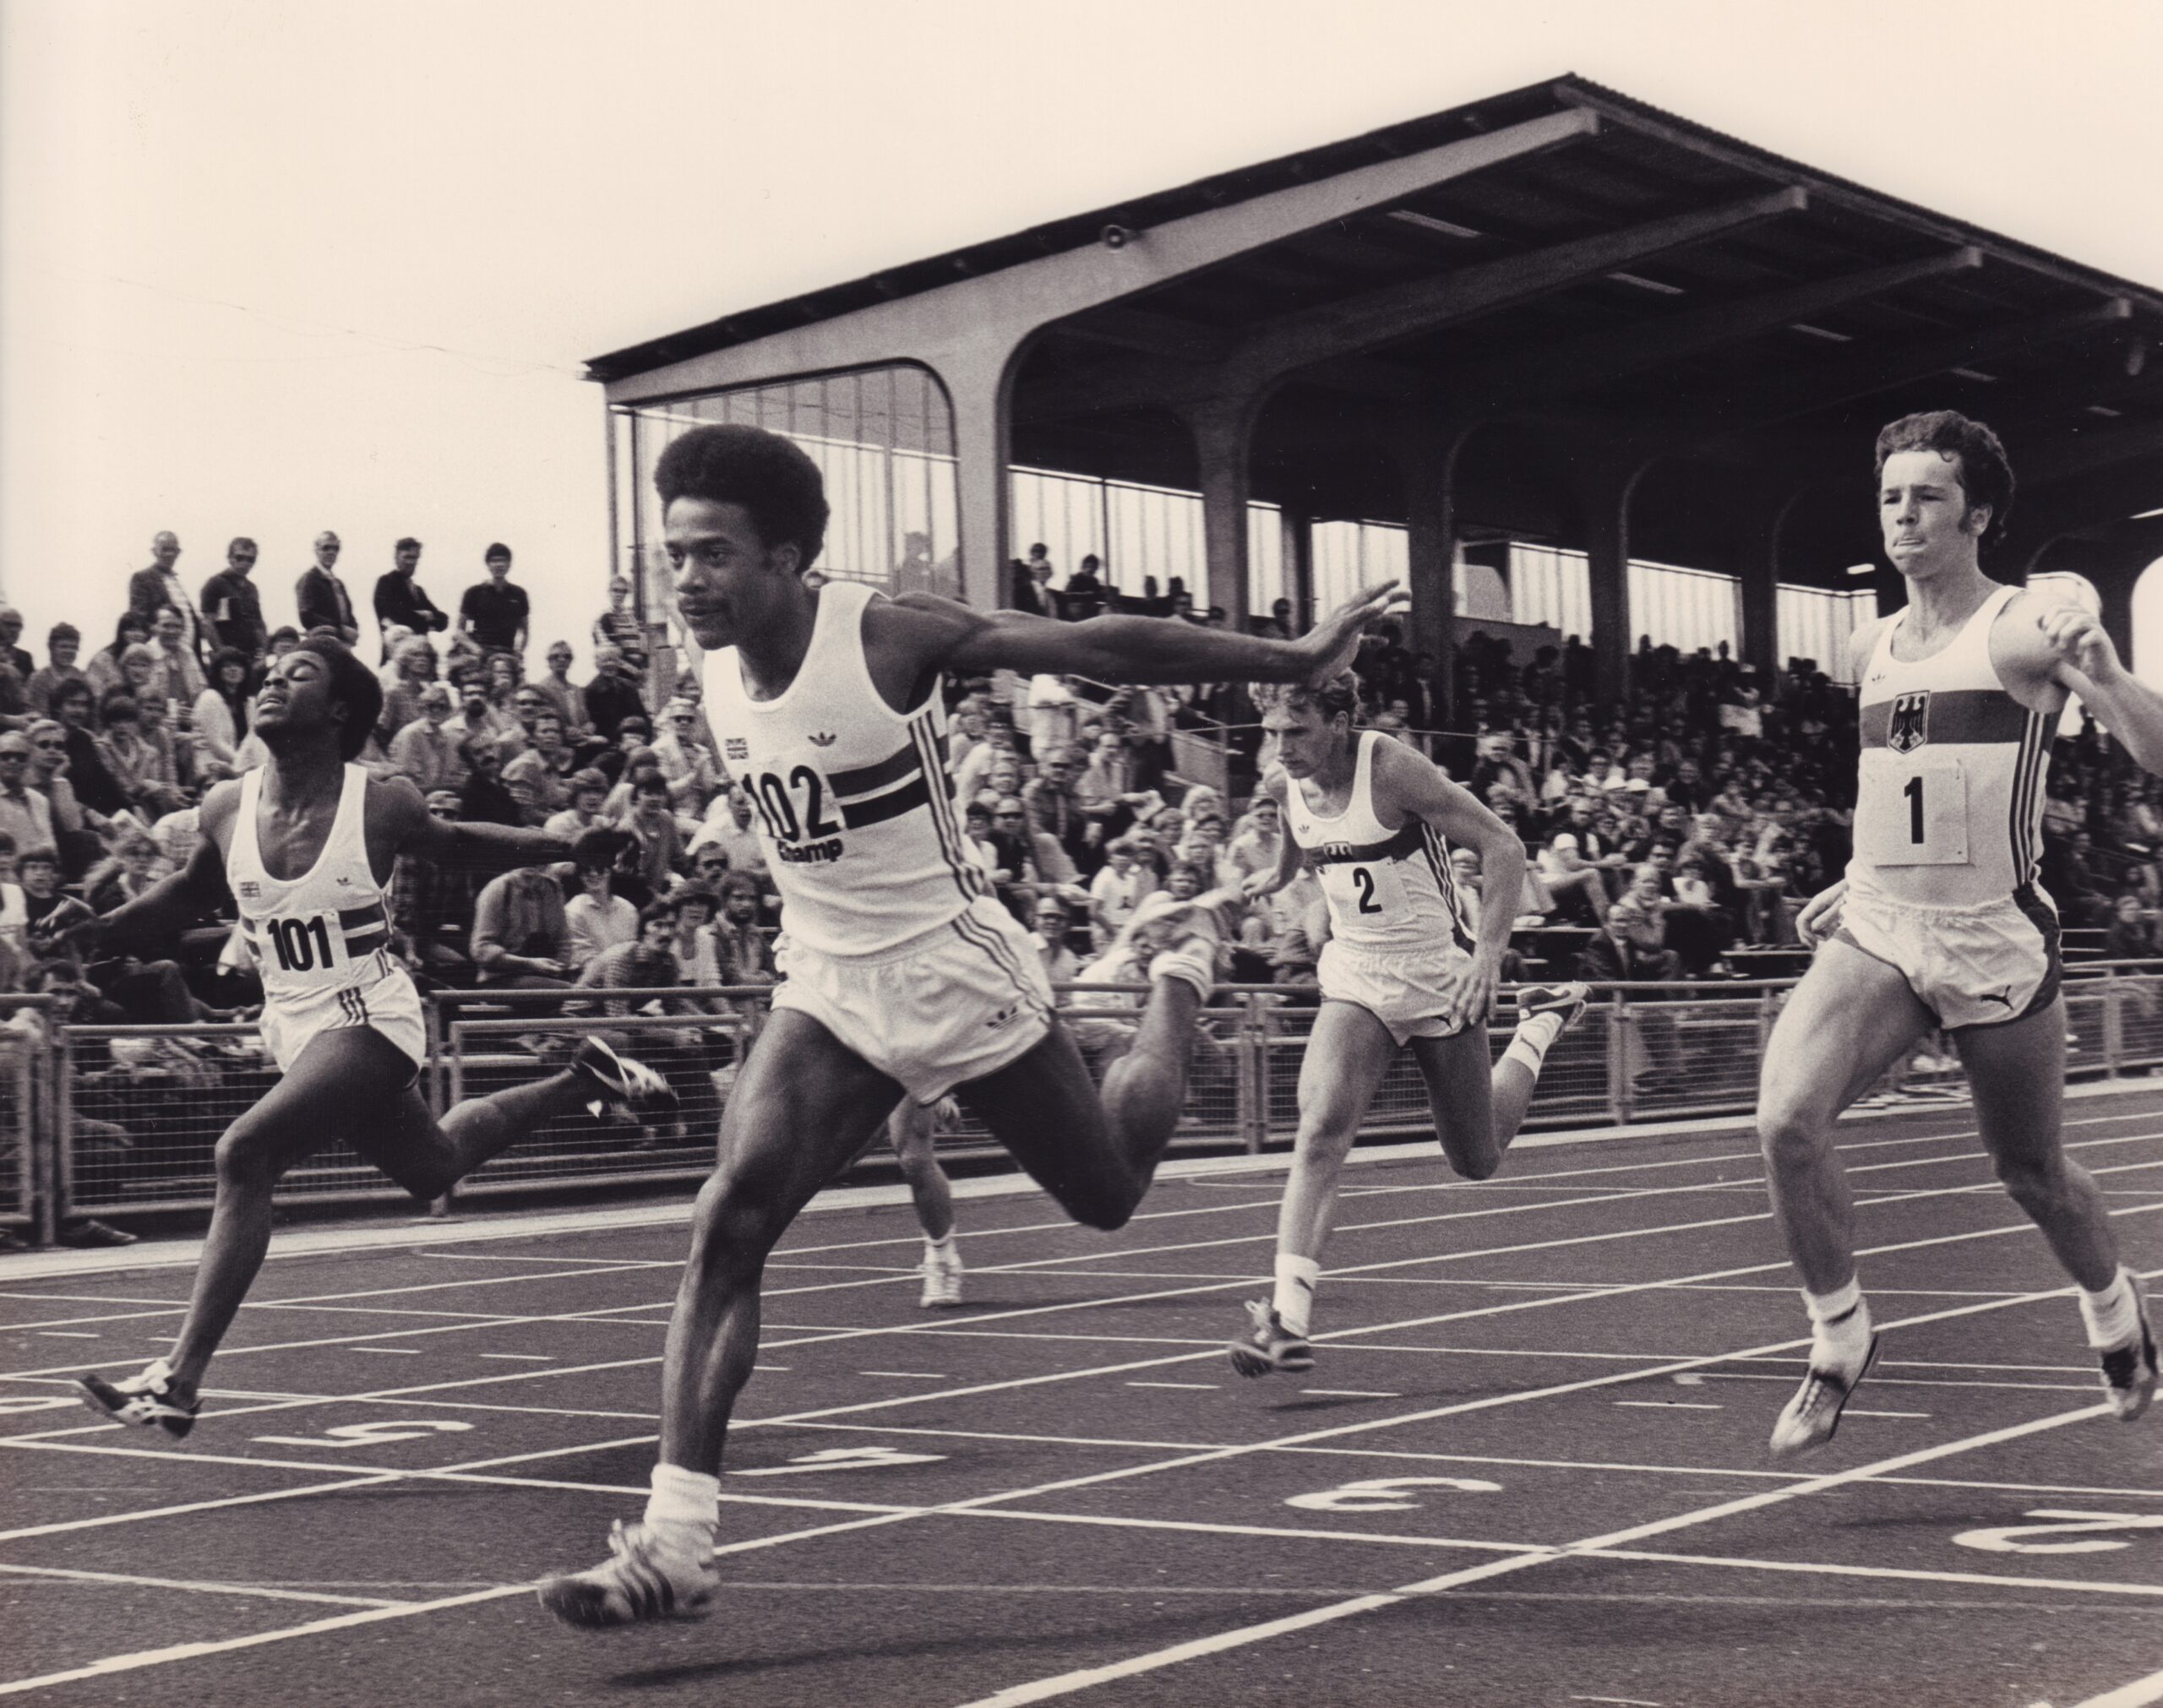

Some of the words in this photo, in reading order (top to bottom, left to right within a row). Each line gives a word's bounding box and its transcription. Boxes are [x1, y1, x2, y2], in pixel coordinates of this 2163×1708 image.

[742, 764, 842, 842] 102
[1904, 776, 1924, 844] 1
[1353, 867, 1382, 914] 2
[267, 915, 334, 971] 101
[1284, 1477, 1503, 1511] 3
